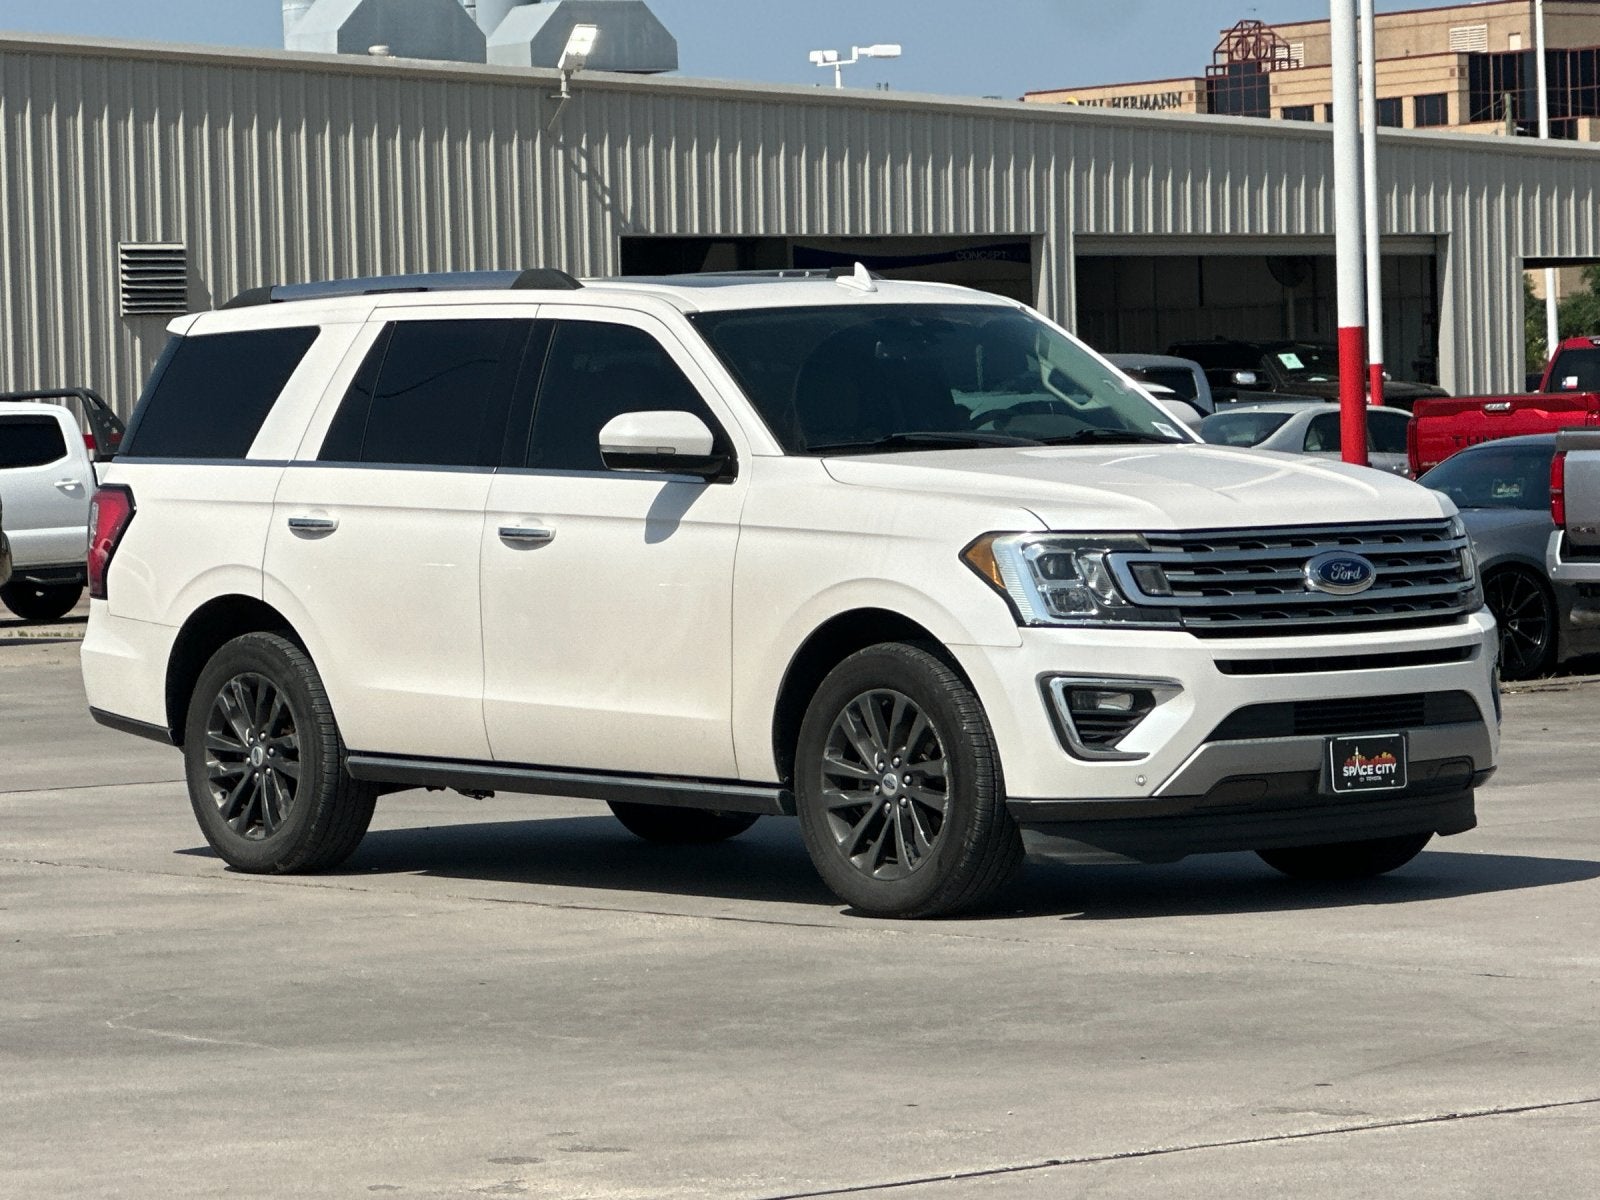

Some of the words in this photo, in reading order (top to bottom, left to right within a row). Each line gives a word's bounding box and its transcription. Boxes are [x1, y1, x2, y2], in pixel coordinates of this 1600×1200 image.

[1111, 91, 1182, 110] HERMANN
[1331, 562, 1362, 580] Ford
[1342, 764, 1374, 777] SPACE
[1375, 763, 1397, 775] CITY
